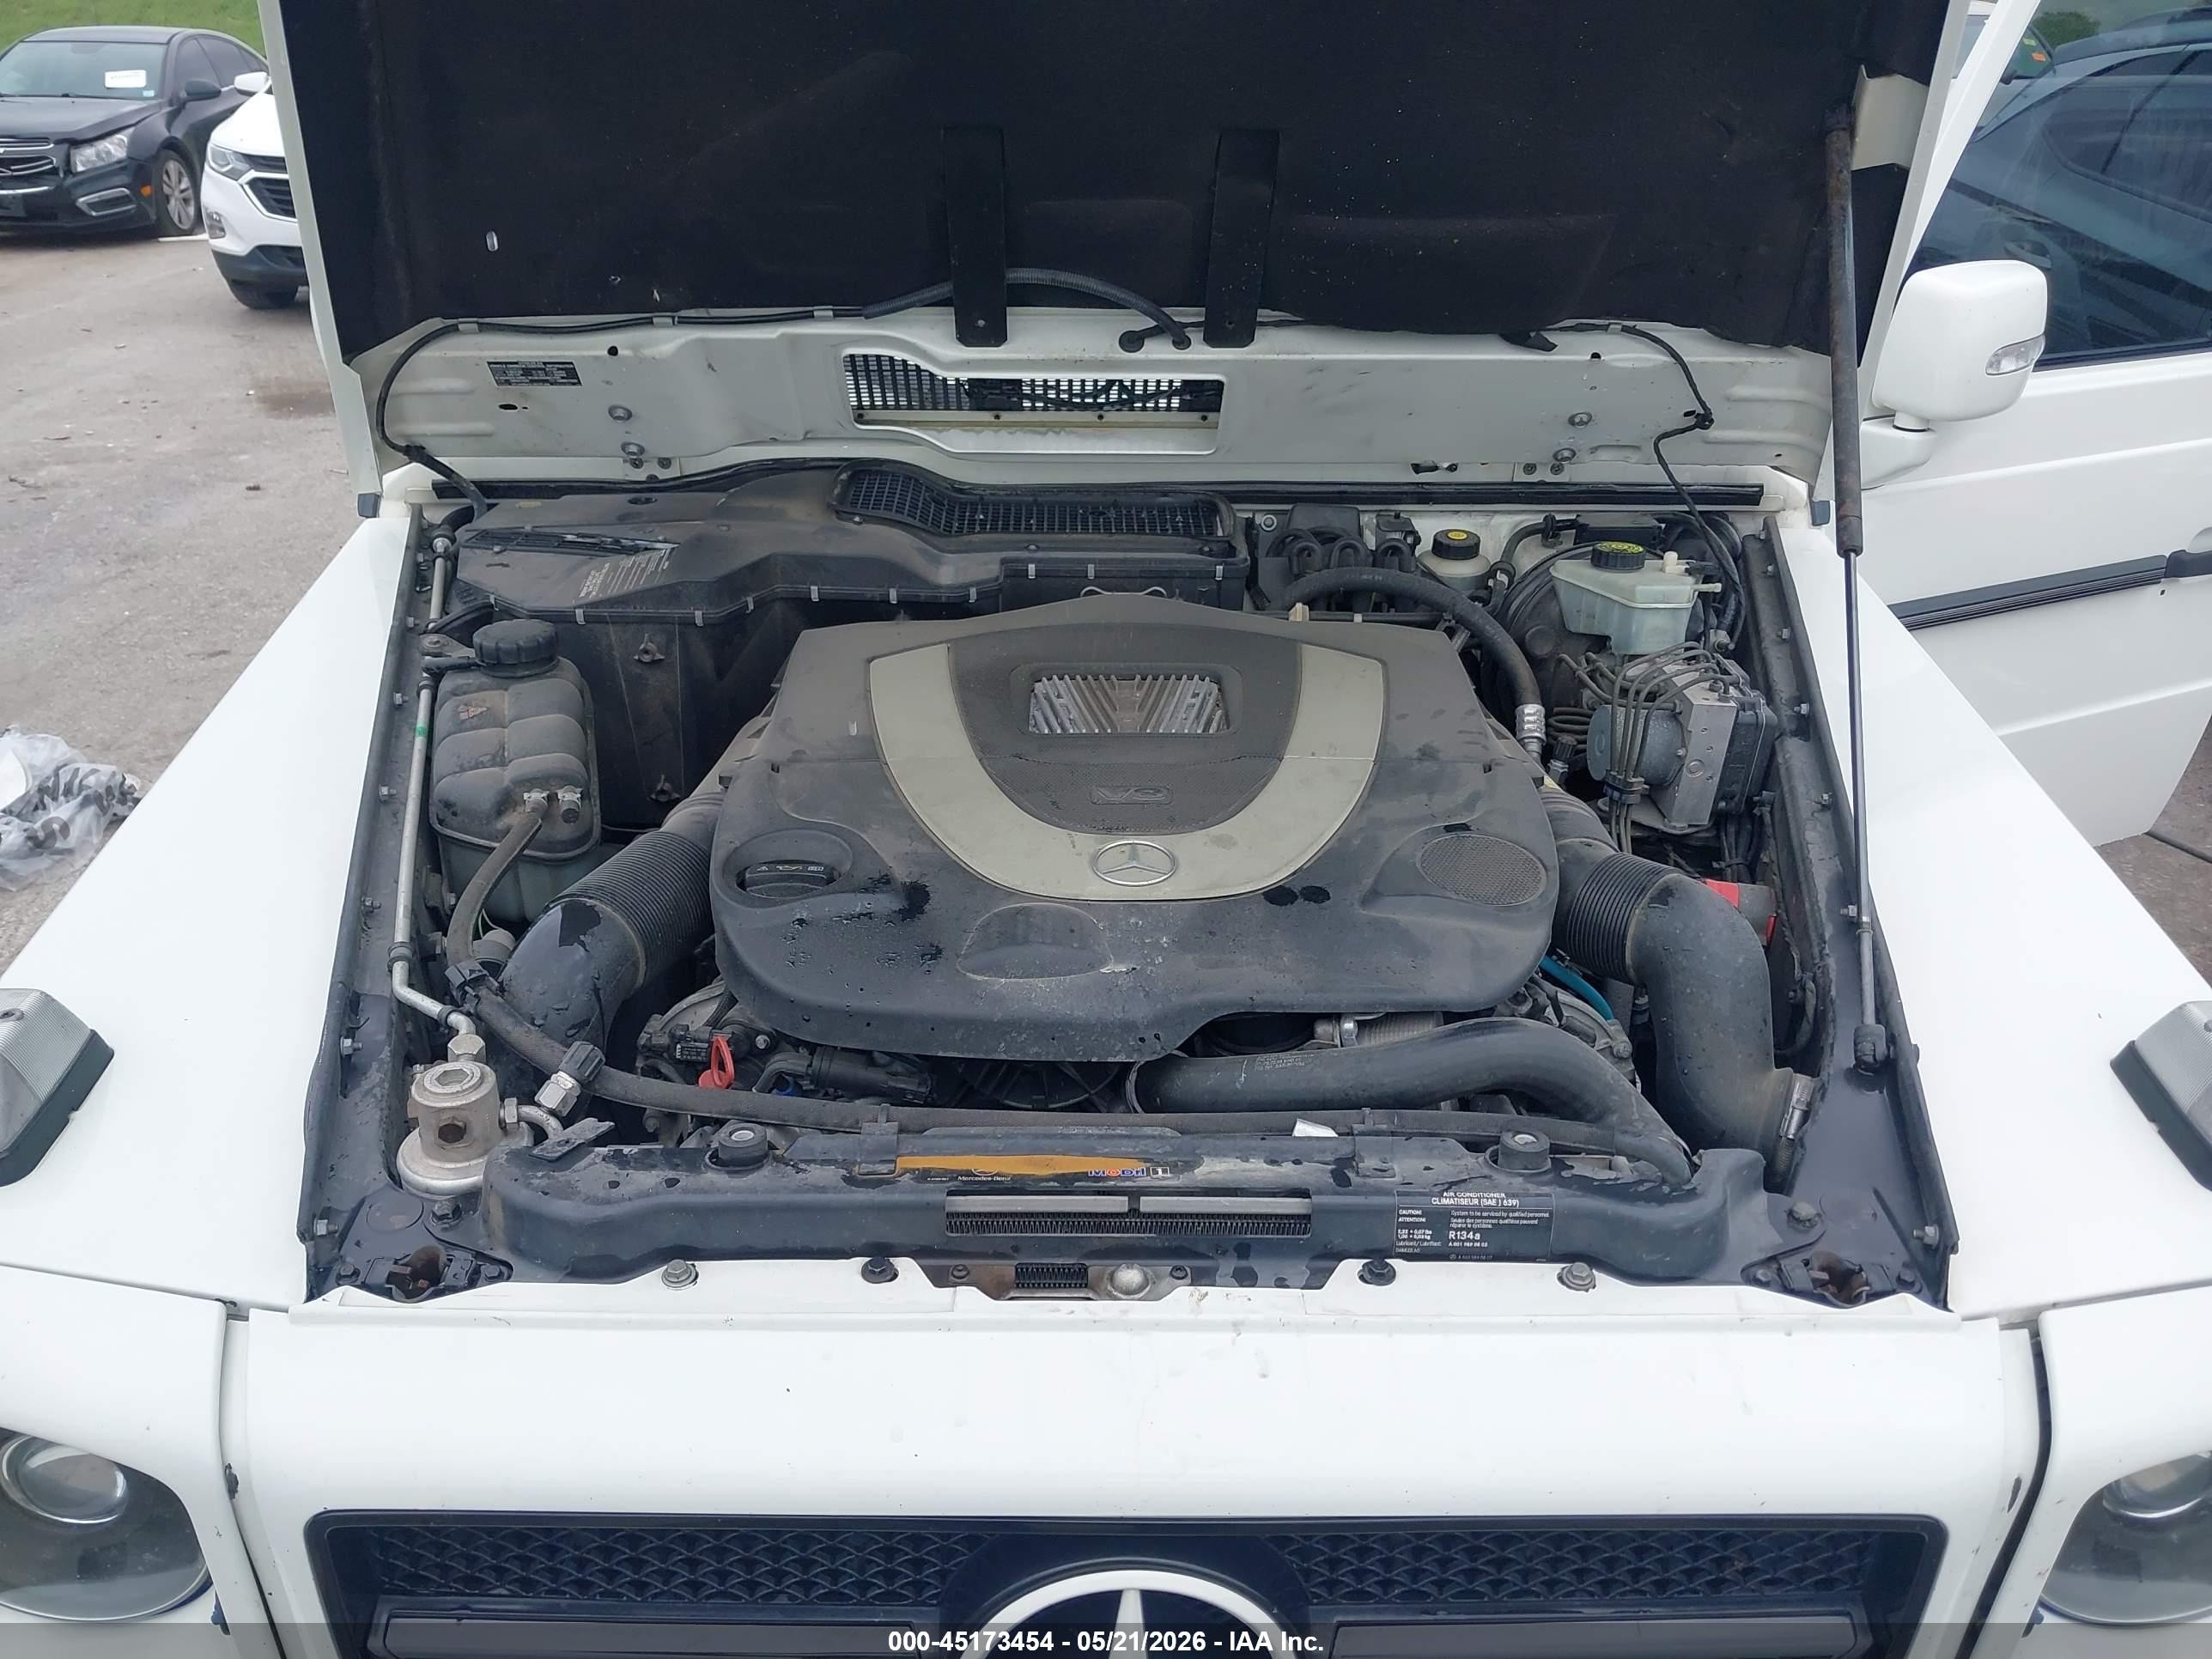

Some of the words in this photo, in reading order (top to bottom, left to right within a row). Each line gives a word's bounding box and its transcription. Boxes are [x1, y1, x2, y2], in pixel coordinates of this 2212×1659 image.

[1431, 1197, 1479, 1205] CLIMATISEUR
[1481, 1199, 1497, 1208] (SAE
[1503, 1199, 1519, 1208] 639)
[1449, 1231, 1480, 1240] R134a
